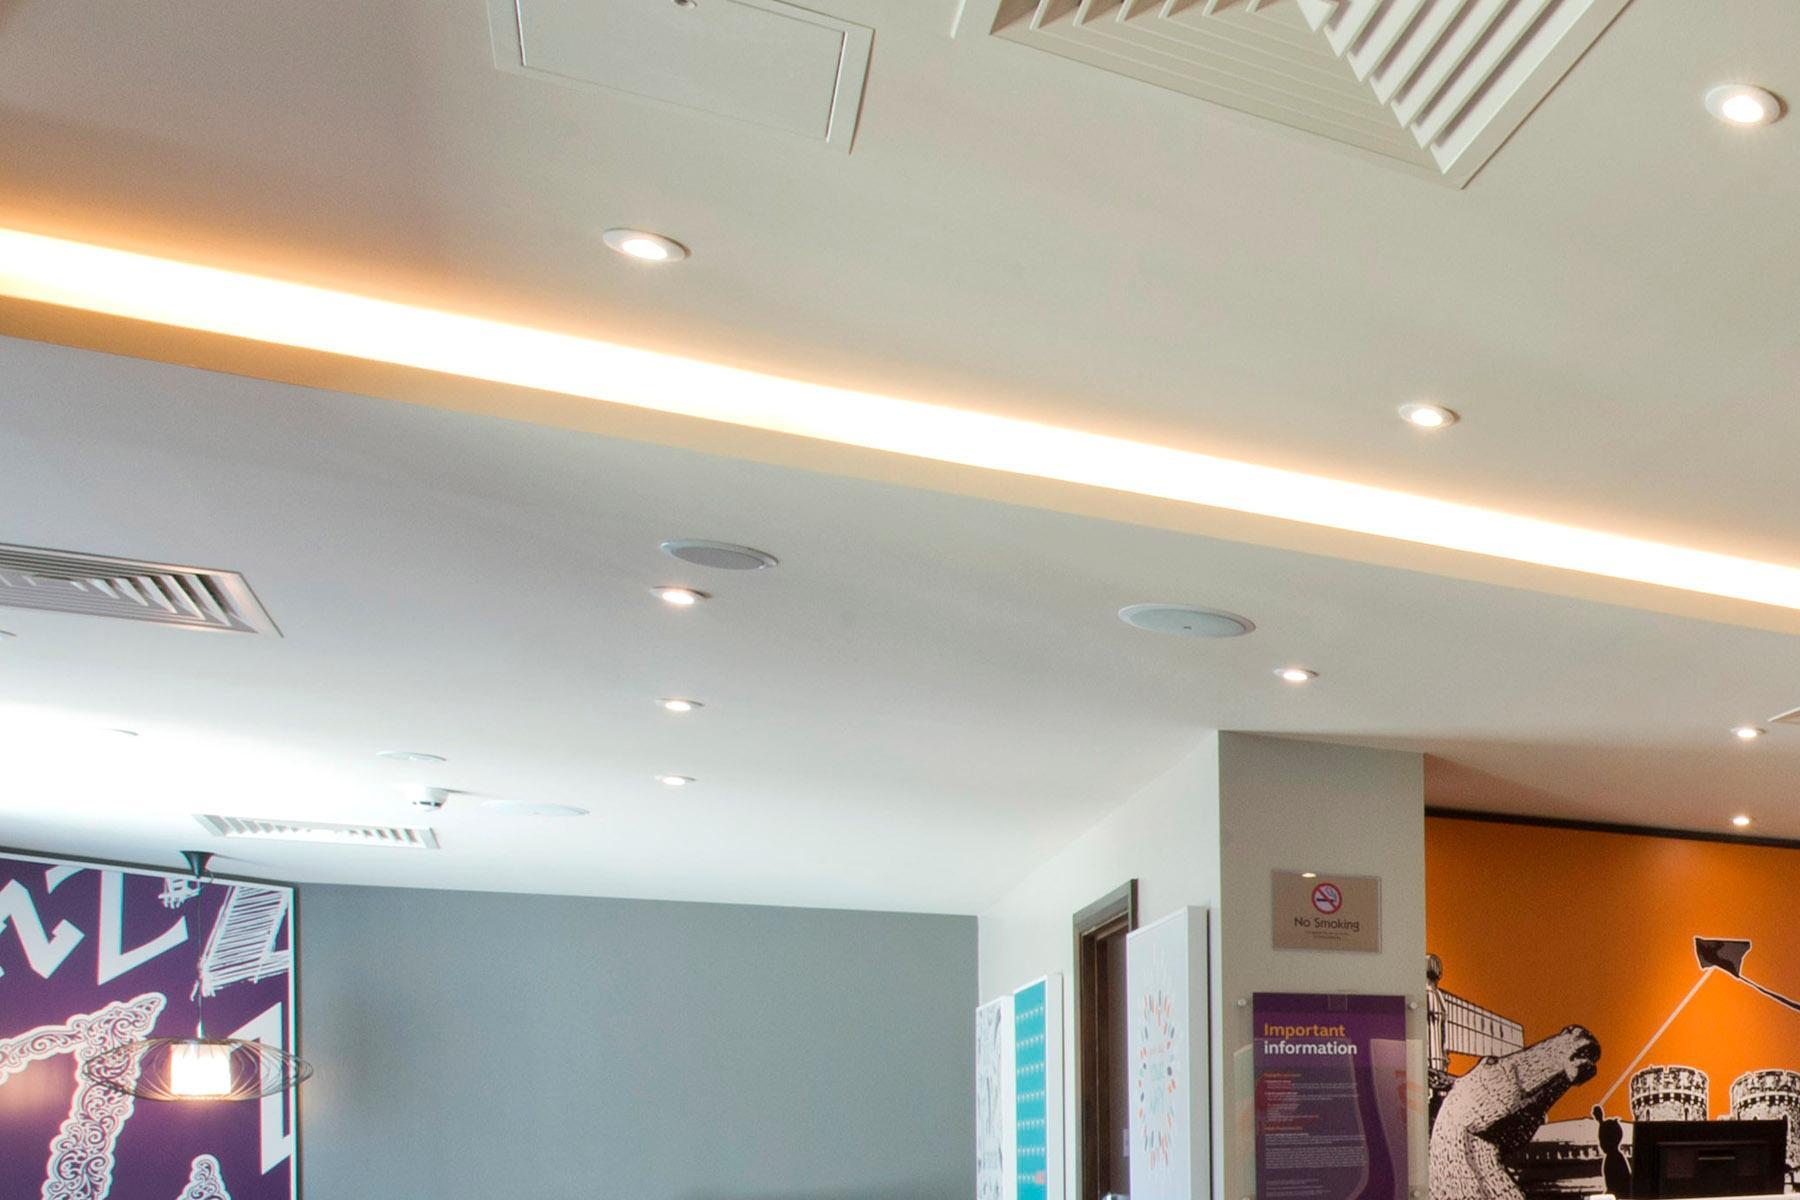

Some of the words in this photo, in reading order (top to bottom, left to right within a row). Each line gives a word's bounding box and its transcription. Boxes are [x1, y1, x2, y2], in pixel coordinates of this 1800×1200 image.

[1294, 916, 1311, 928] No
[1314, 917, 1360, 933] Smoking
[1264, 1023, 1345, 1040] Important
[1264, 1041, 1358, 1055] information
